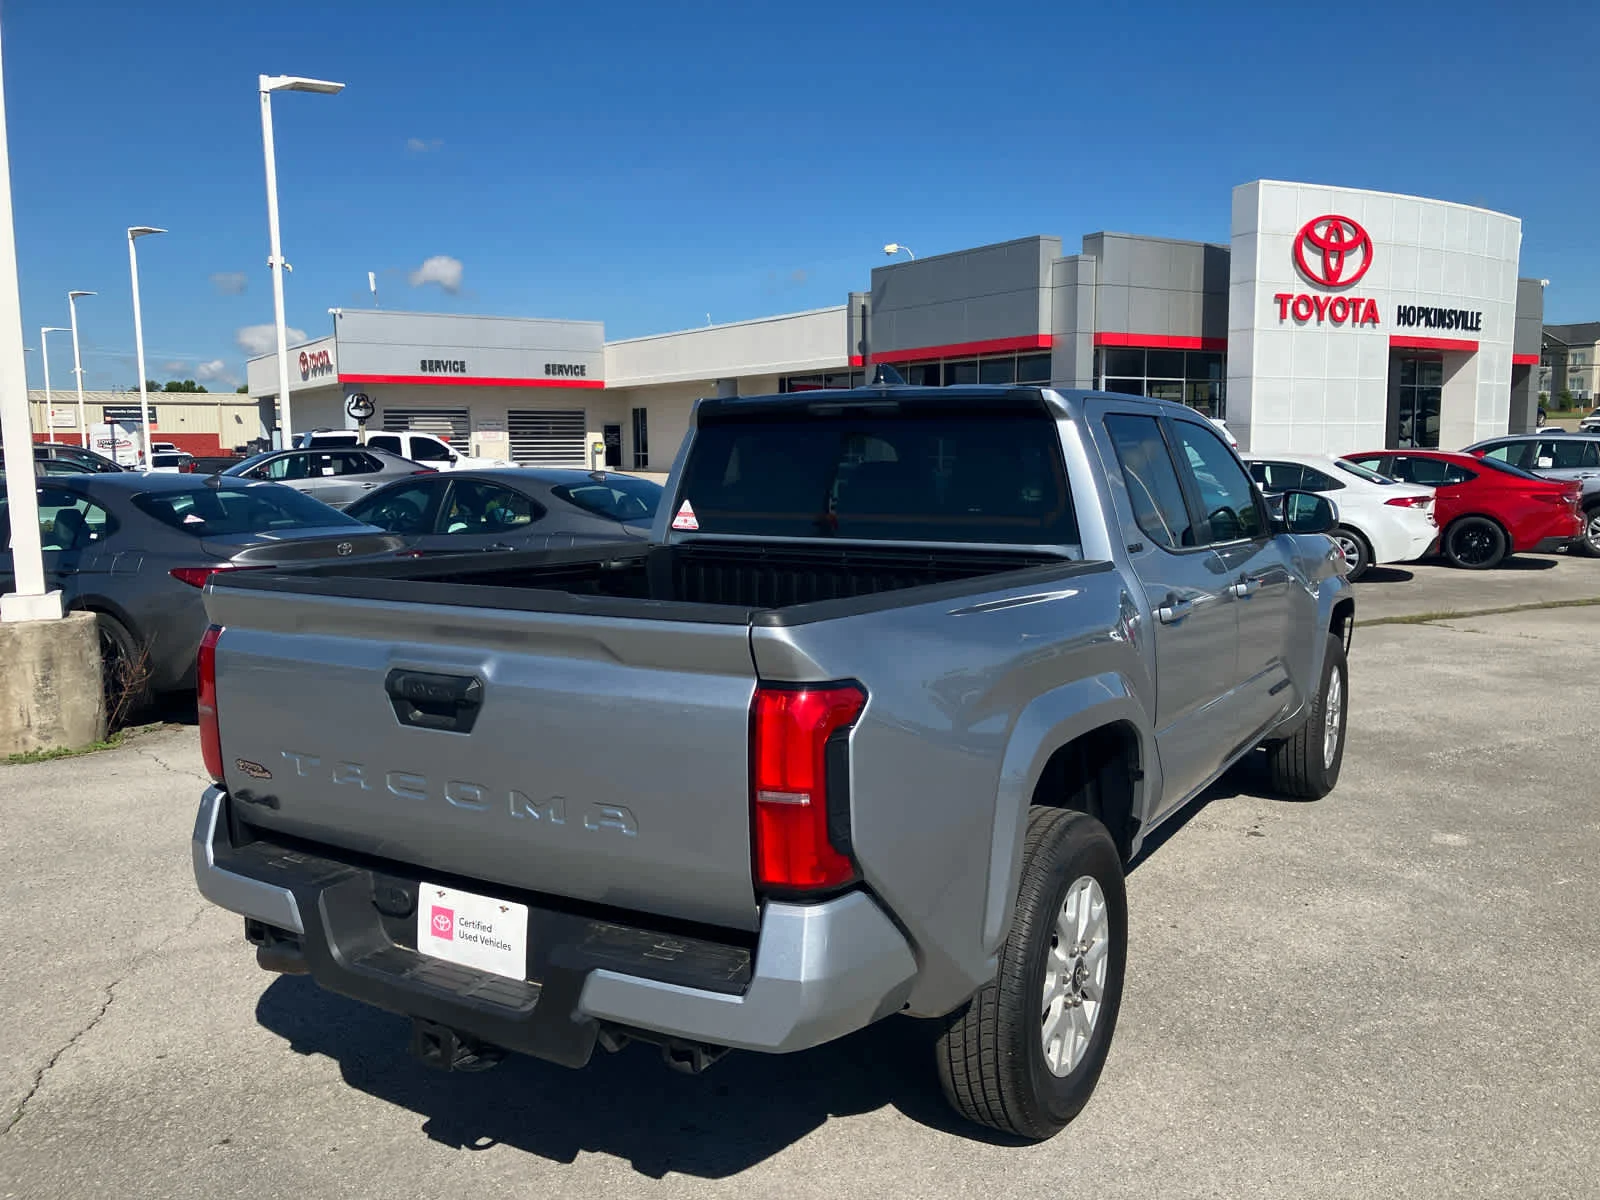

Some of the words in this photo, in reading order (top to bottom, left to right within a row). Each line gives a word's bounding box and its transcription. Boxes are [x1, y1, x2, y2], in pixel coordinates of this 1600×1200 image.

[1274, 294, 1381, 324] TOYOTA
[1396, 305, 1483, 331] HOPKINSVILLE
[420, 359, 466, 374] SERVICE
[544, 363, 586, 377] SERVICE
[280, 751, 640, 838] TACOMA
[458, 917, 493, 933] Certified
[458, 929, 478, 942] Used
[480, 935, 512, 952] Vehicles
